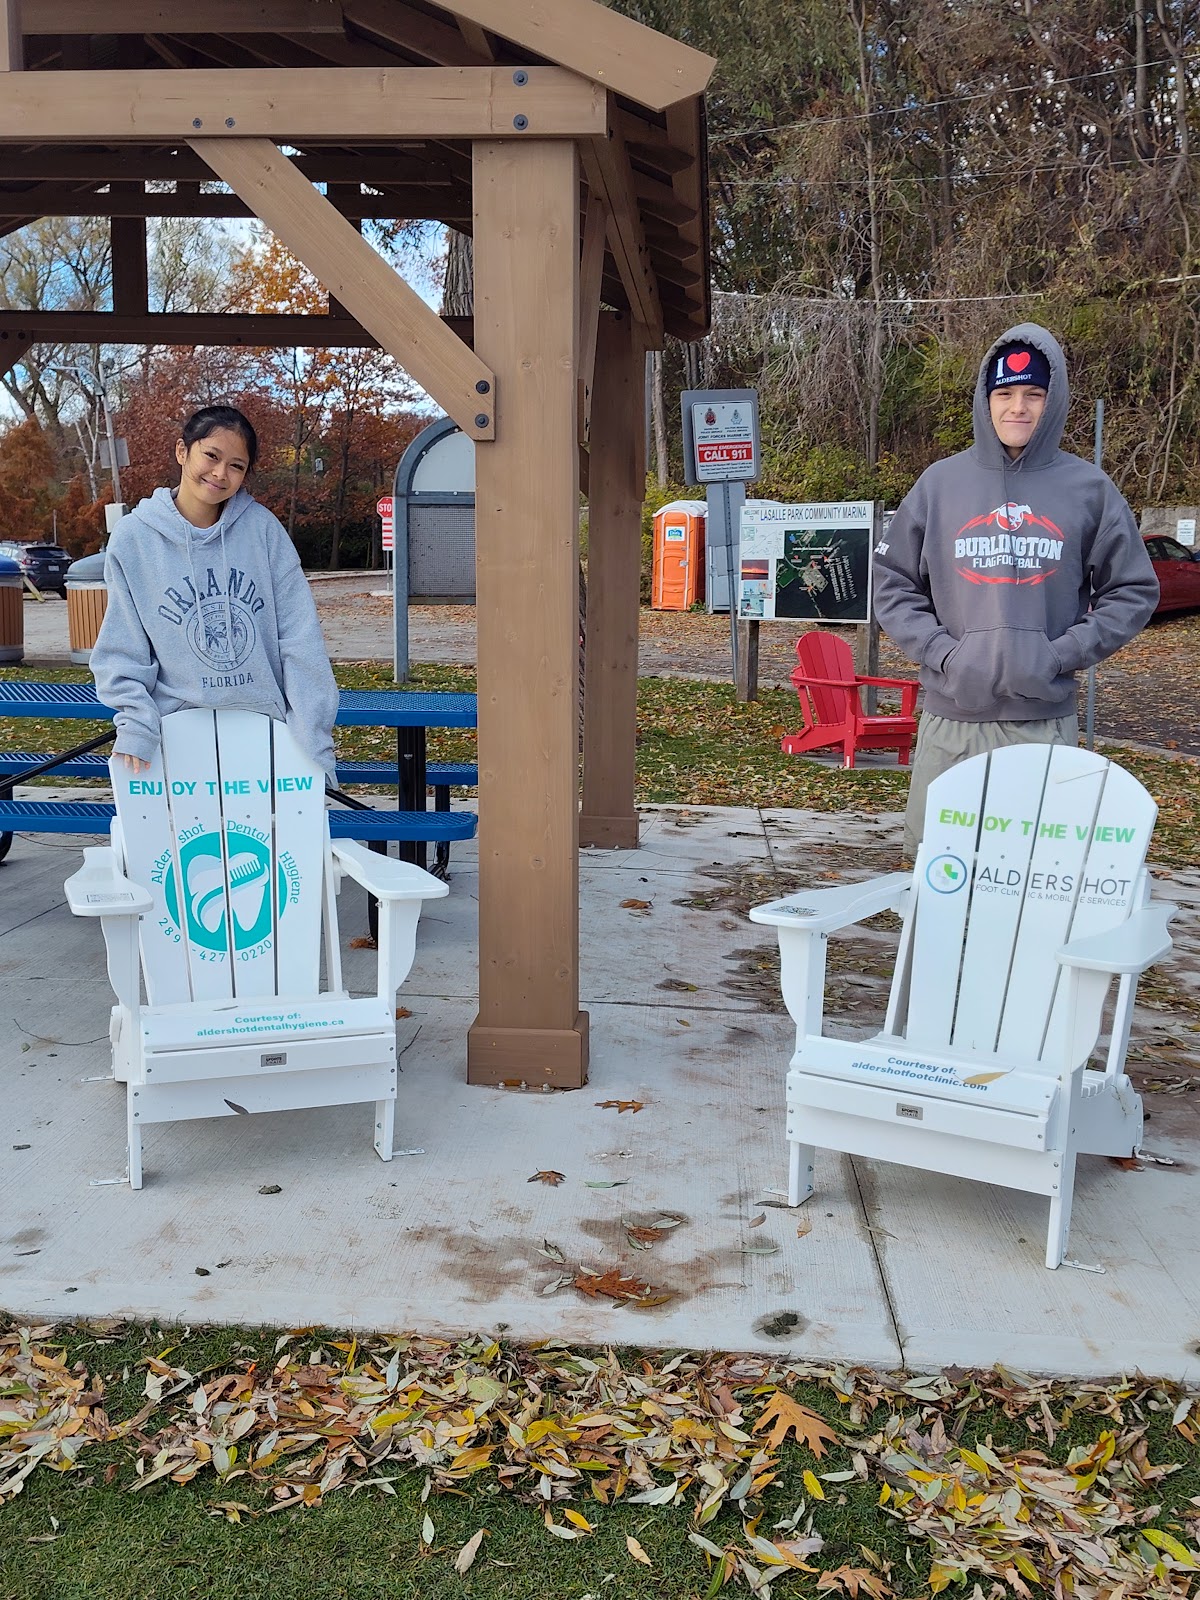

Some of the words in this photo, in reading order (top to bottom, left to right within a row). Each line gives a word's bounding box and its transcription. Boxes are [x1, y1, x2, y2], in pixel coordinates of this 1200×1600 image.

[996, 357, 1004, 378] I
[995, 374, 1032, 385] ALDERSHOT
[704, 450, 730, 461] CALL
[731, 449, 747, 460] 911
[378, 503, 392, 513] STO
[760, 508, 786, 521] LASALLE
[787, 508, 804, 520] PARK
[804, 507, 842, 520] COMMUNITY
[842, 506, 867, 519] MARINA
[954, 533, 1064, 561] BURLINGTON
[972, 557, 997, 568] FLAG
[157, 567, 265, 626] ORLANDO
[201, 672, 255, 689] FLORIDA
[129, 780, 197, 796] ENJOY
[205, 780, 250, 796] THE
[257, 776, 313, 793] VIEW
[939, 808, 1013, 833] ENJOY
[1020, 820, 1068, 840] THE
[1075, 825, 1136, 844] VIEW
[226, 819, 271, 844] Dental
[279, 850, 303, 905] Hygiene
[978, 866, 1131, 897] ALDERSHOT
[975, 883, 999, 895] FOOT
[1000, 887, 1037, 899] CLINIC
[1037, 892, 1044, 900] &
[1045, 892, 1085, 904] MOBILE
[1087, 896, 1127, 908] SERVICES
[196, 1018, 345, 1037] aldershotdentalhygiene.ca
[234, 1013, 285, 1025] Courtesy
[287, 1012, 302, 1021] of:
[887, 1056, 940, 1073] Courtesy
[941, 1066, 957, 1076] of:
[851, 1061, 988, 1092] aldershotfootclinic.com
